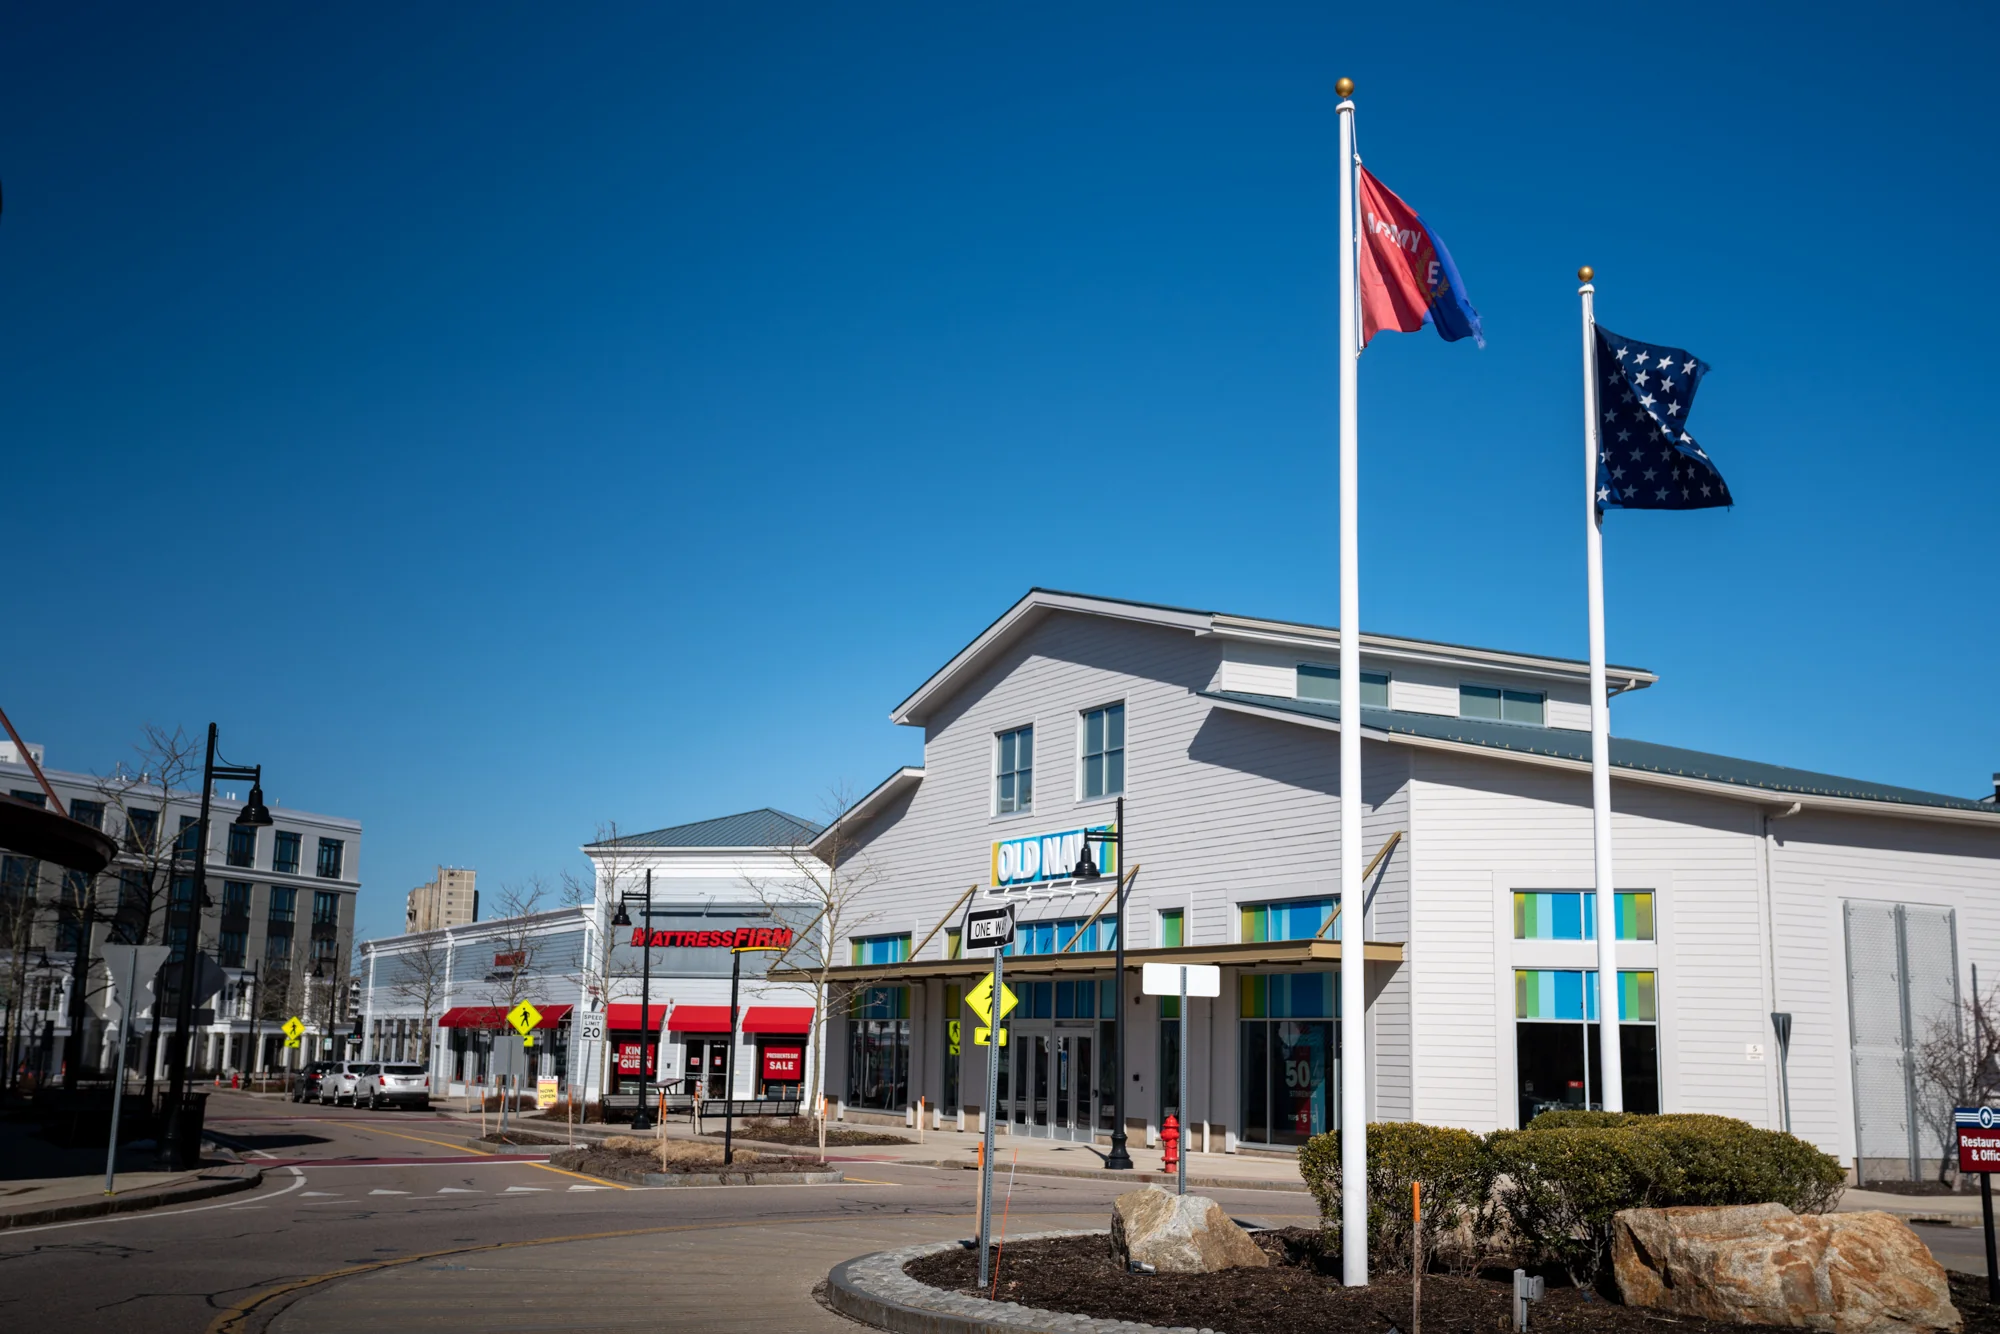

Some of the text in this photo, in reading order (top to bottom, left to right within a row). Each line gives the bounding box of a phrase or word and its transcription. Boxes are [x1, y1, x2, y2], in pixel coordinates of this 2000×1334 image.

[1427, 261, 1441, 285] E
[998, 841, 1040, 882] OLD
[975, 922, 991, 938] ONE
[583, 1027, 600, 1038] 20
[625, 1046, 649, 1056] KIN
[621, 1059, 652, 1068] QUEN
[769, 1061, 794, 1070] SALE
[1961, 1135, 2000, 1148] Restaura
[1971, 1149, 2000, 1161] & Offic
